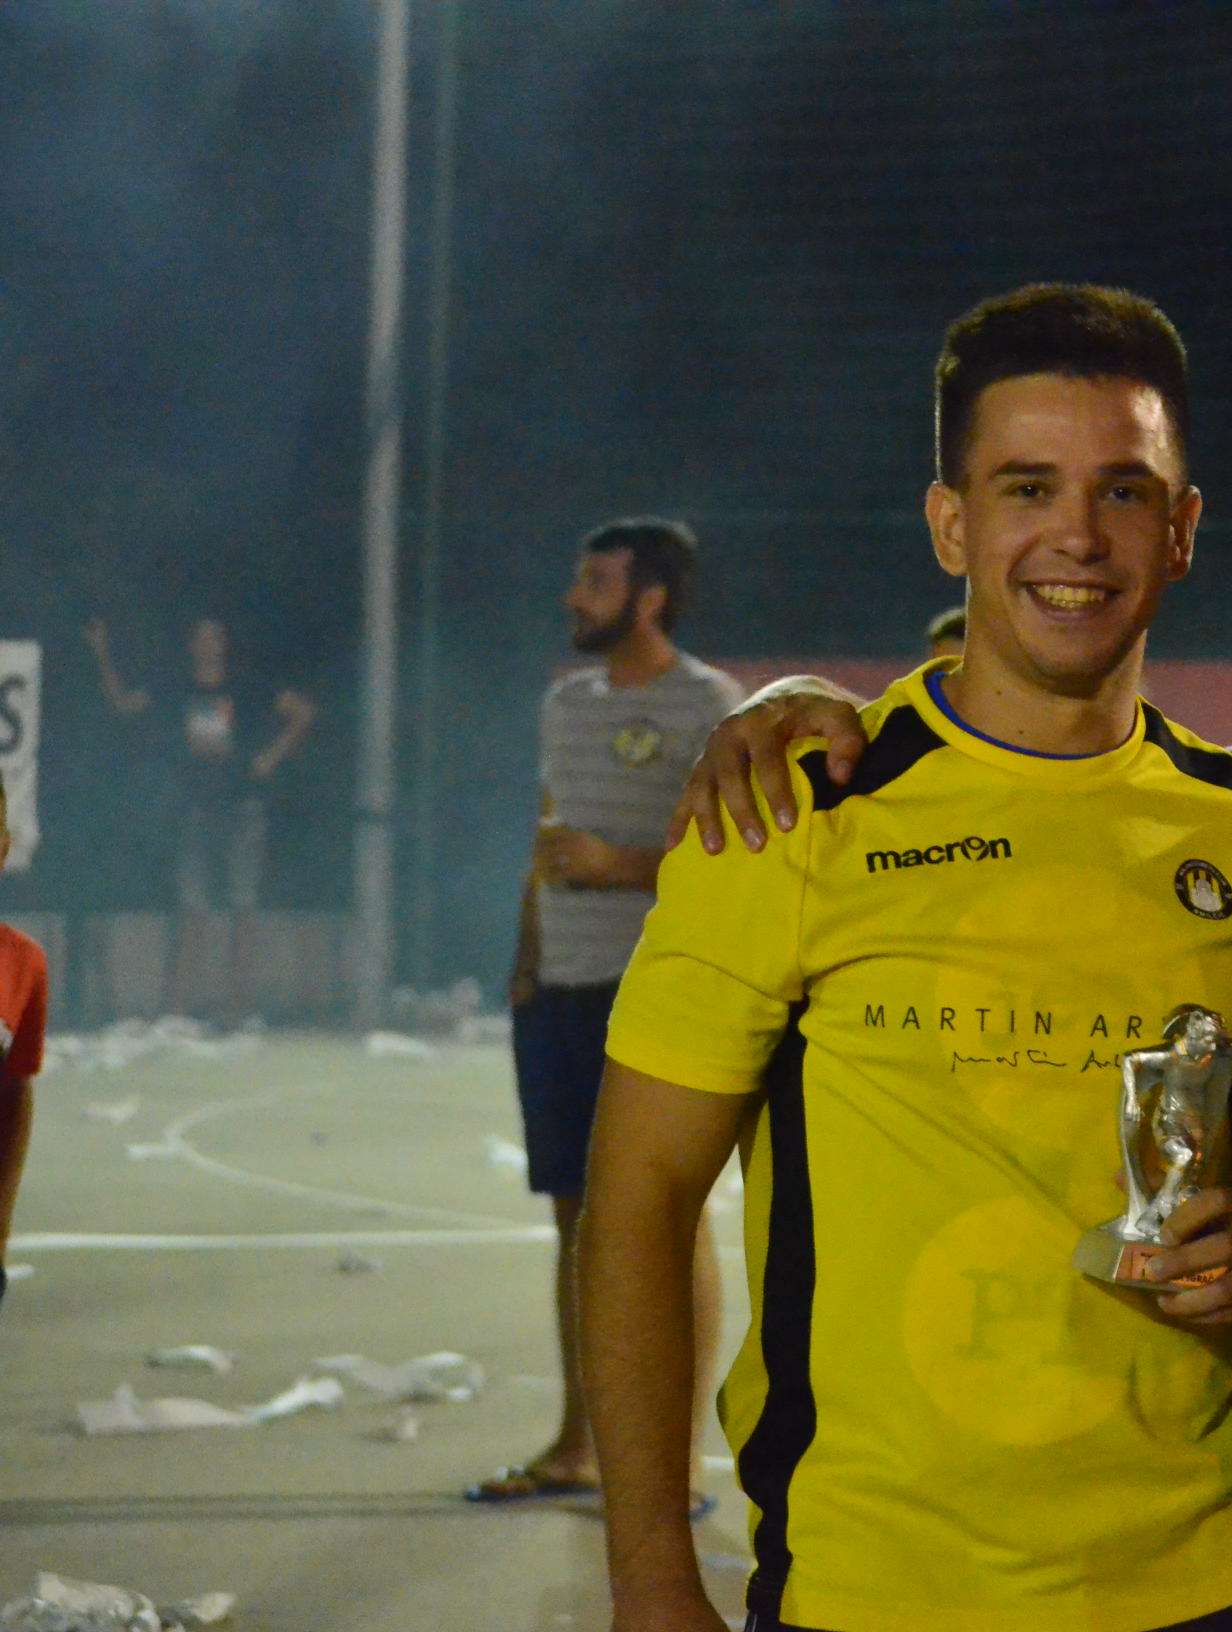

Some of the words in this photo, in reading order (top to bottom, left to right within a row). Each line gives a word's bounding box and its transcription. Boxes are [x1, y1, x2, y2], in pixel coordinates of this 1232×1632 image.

[866, 836, 1013, 873] macron
[864, 1004, 1052, 1036] MARTIN
[1090, 1014, 1143, 1039] AR
